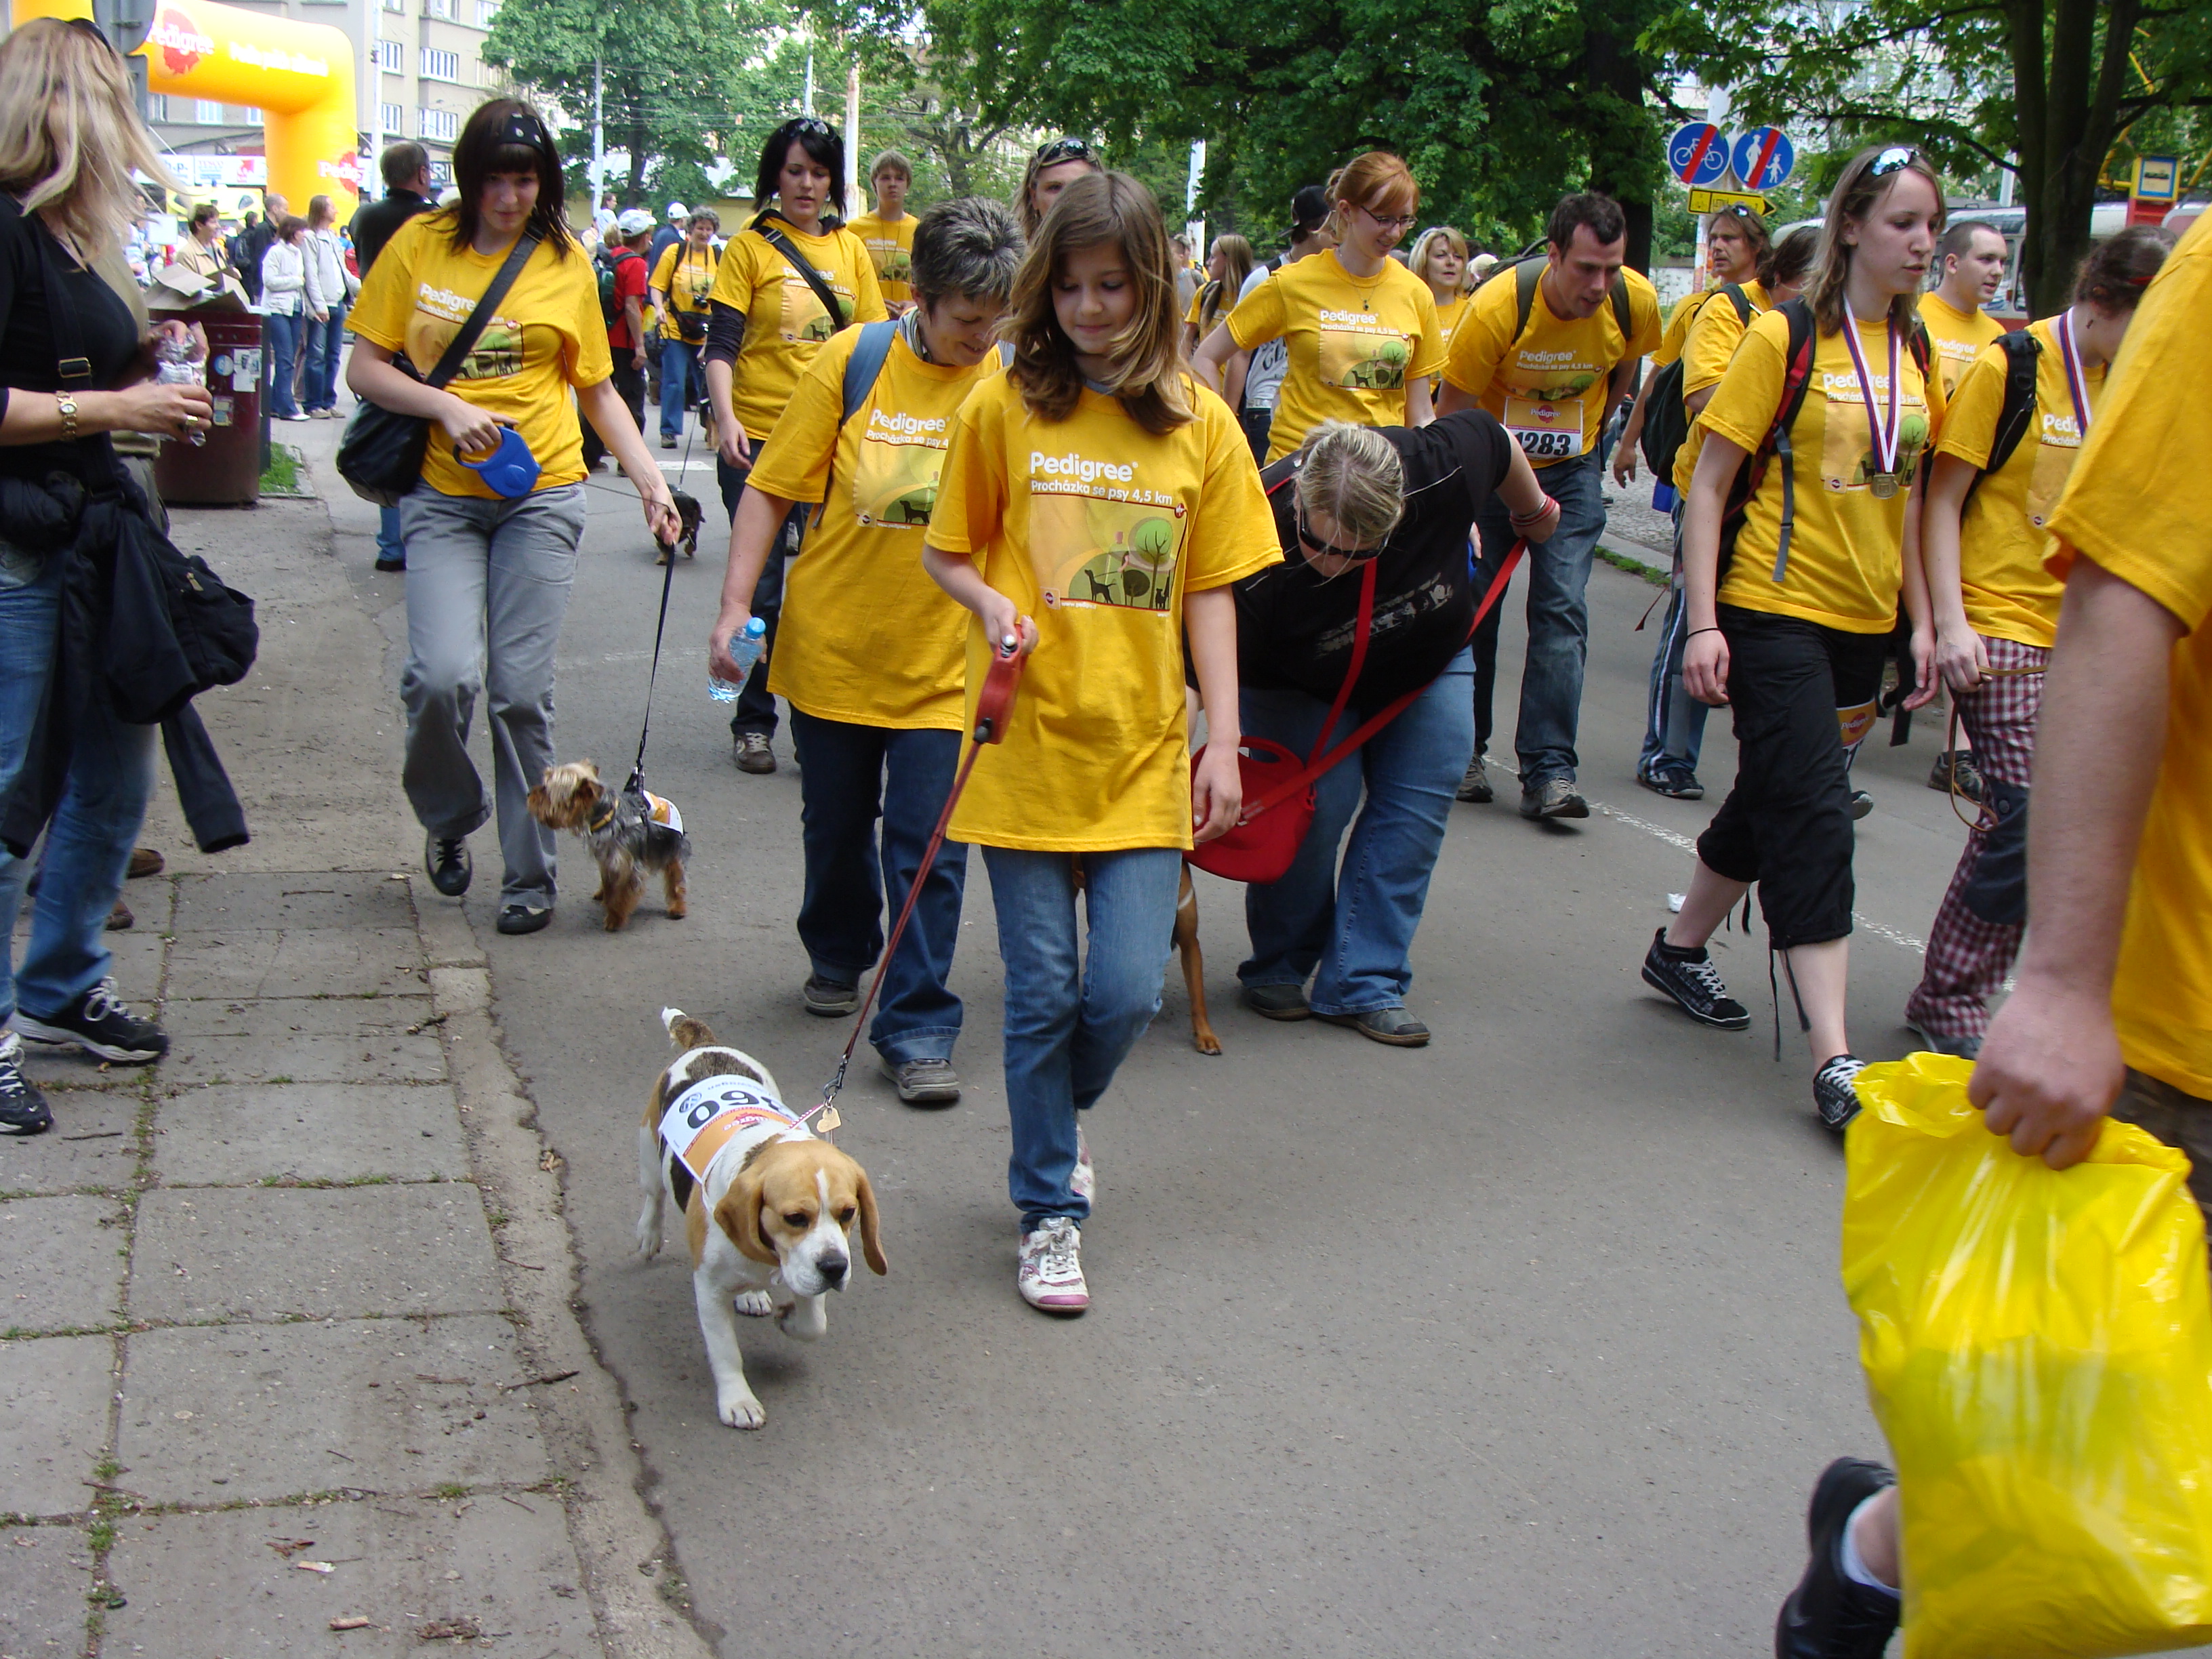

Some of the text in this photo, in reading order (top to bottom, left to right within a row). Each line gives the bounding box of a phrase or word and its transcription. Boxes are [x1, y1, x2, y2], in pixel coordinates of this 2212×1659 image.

[1320, 310, 1376, 325] Pedigree
[1519, 350, 1574, 364] Pedigree
[870, 409, 947, 434] Pedigree
[1530, 409, 1561, 418] Pedigree
[866, 429, 912, 444] Procházka
[914, 436, 925, 444] se
[926, 437, 941, 449] psy
[1030, 452, 1133, 483] Pedigree
[1031, 479, 1173, 505] Procházka se psy 4,5 km
